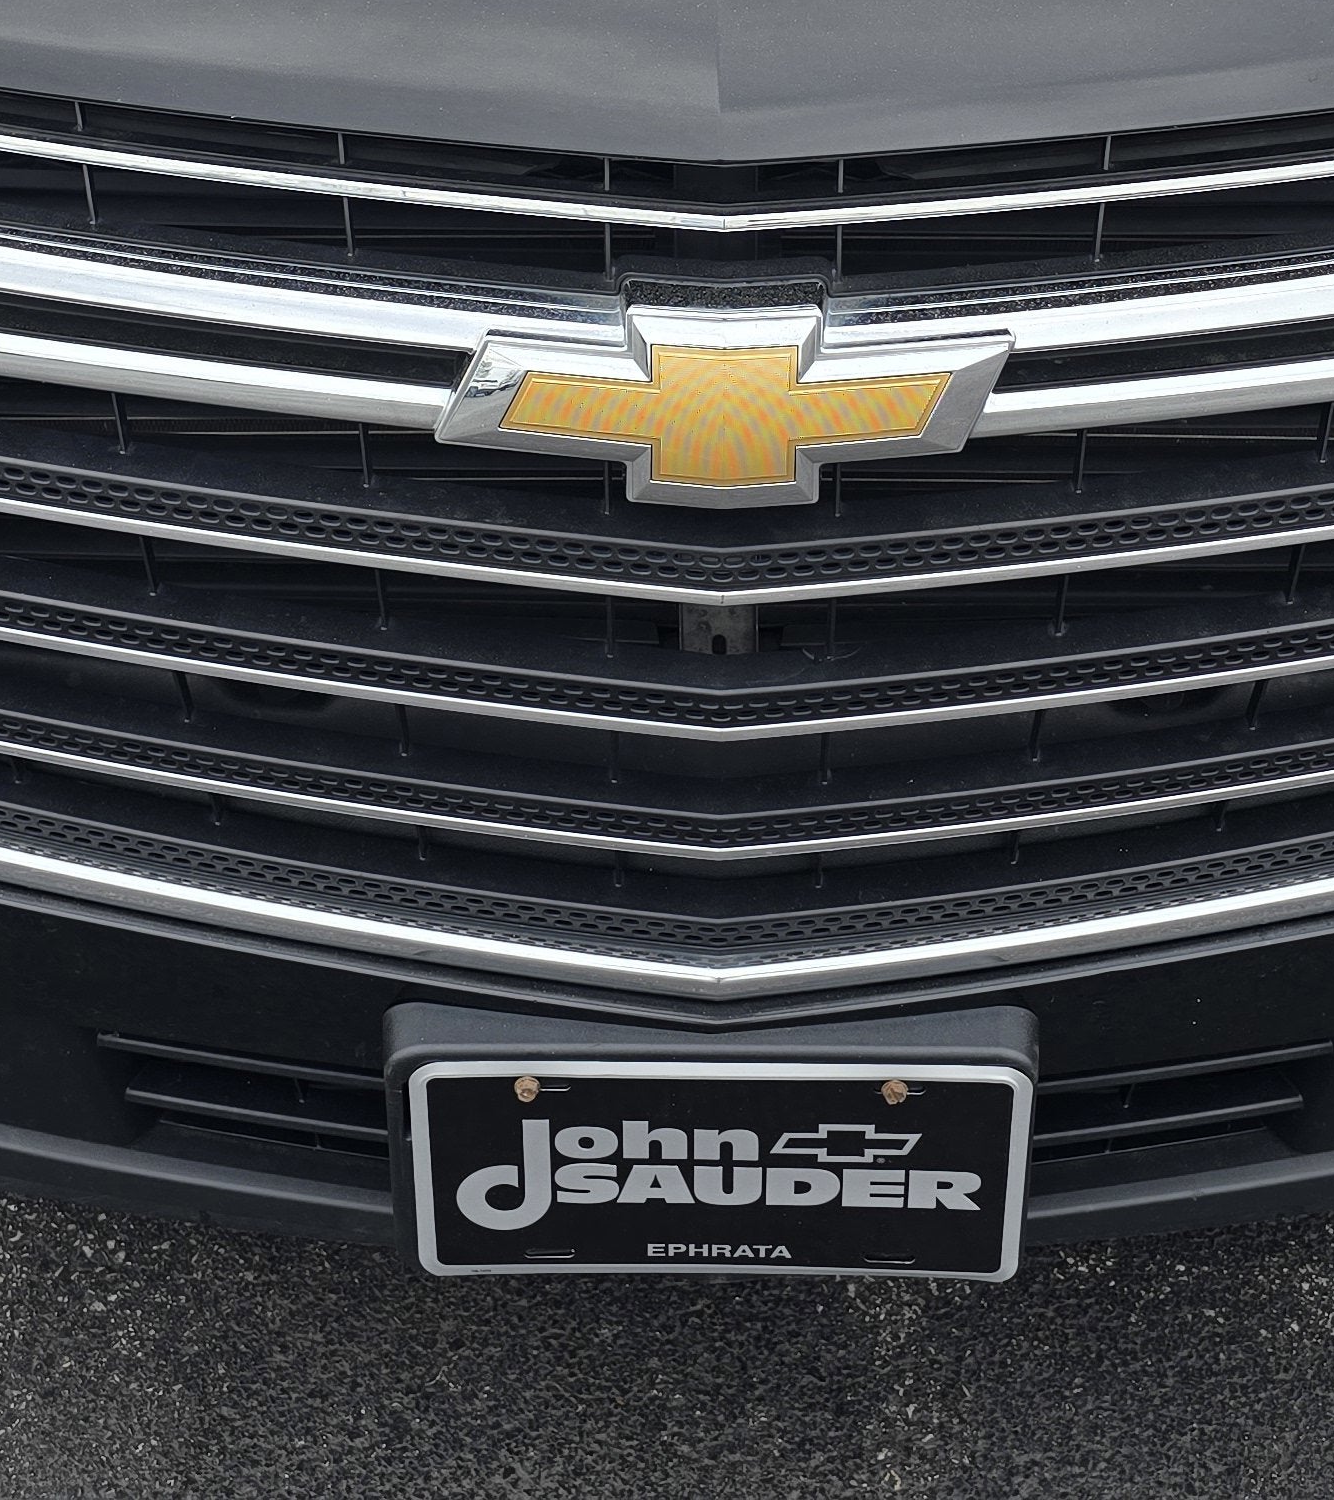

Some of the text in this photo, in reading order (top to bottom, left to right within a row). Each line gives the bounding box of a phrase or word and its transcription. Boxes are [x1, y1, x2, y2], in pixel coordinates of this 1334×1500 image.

[456, 1119, 759, 1231] John
[554, 1163, 982, 1211] SAUDER
[647, 1243, 792, 1259] EPHRATA
